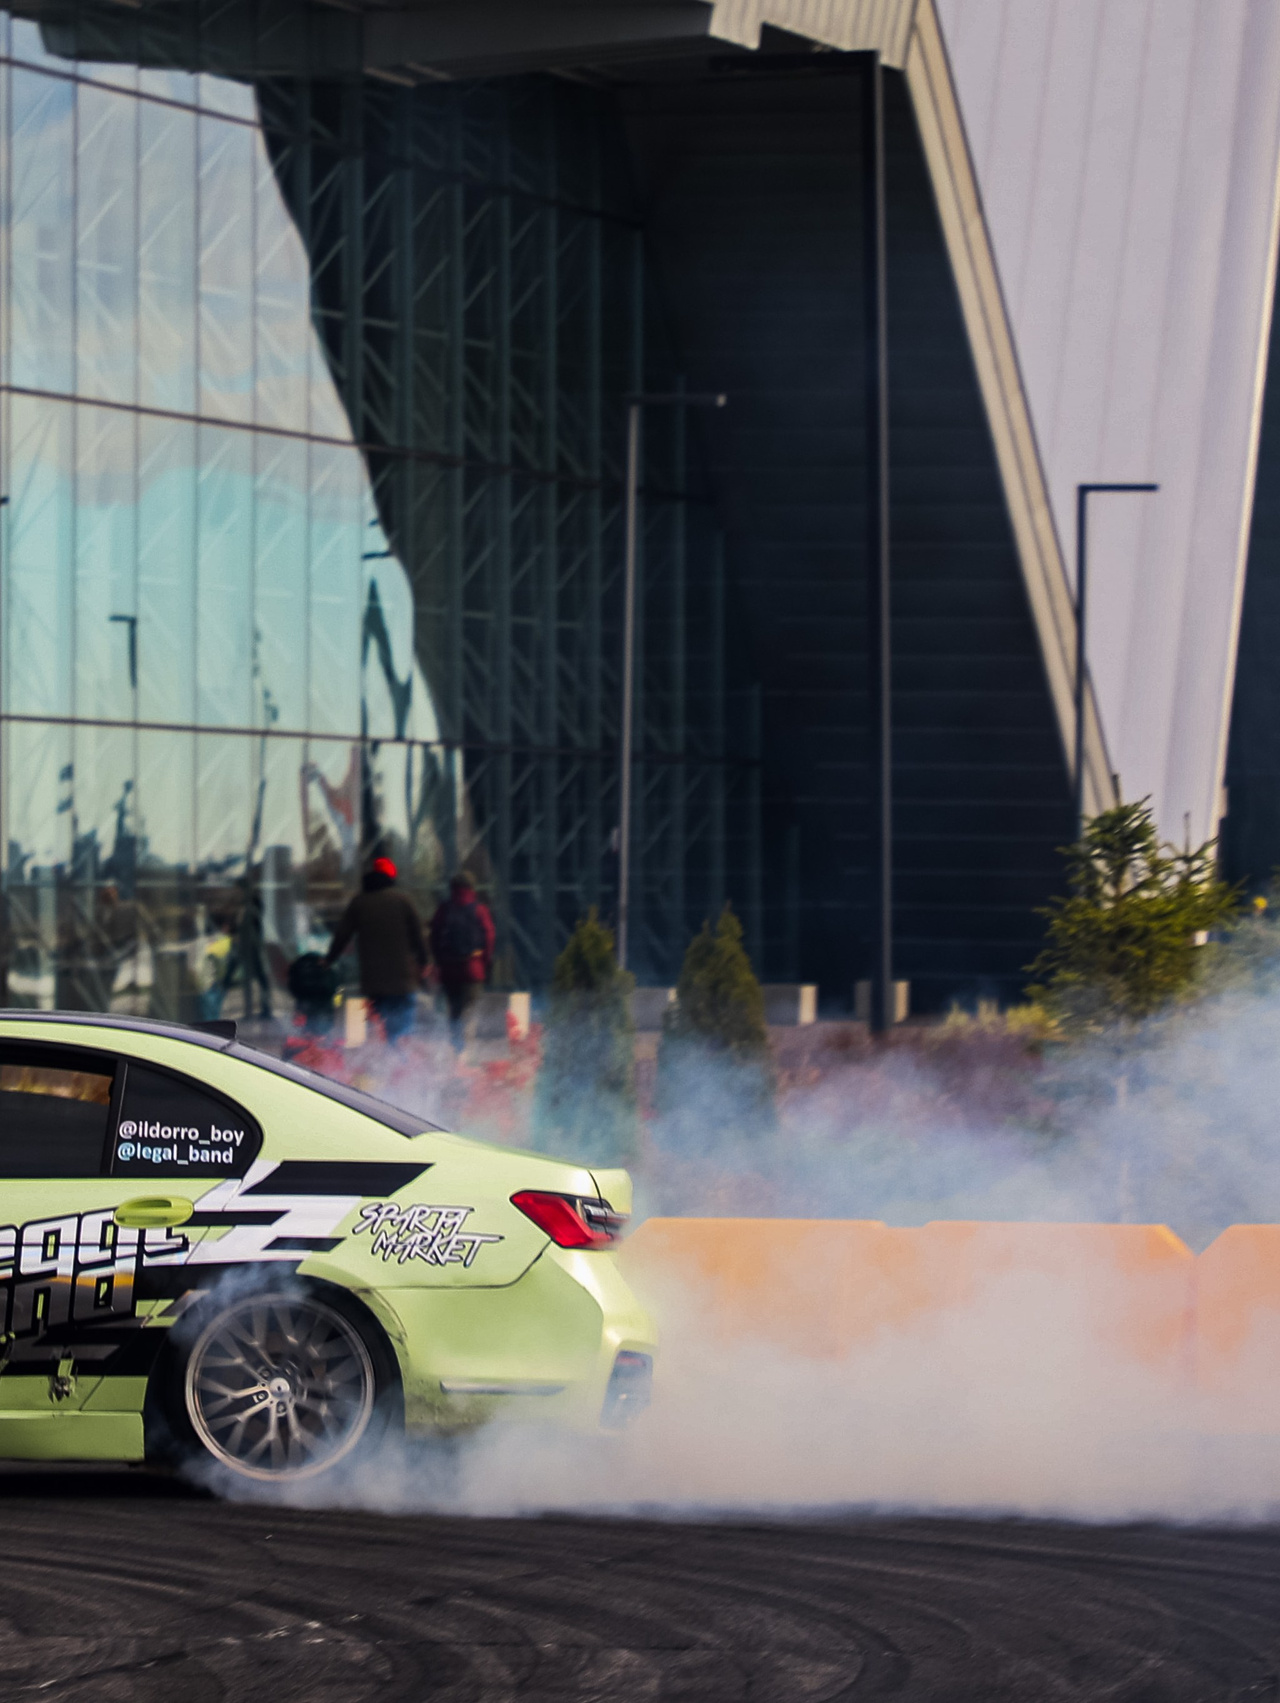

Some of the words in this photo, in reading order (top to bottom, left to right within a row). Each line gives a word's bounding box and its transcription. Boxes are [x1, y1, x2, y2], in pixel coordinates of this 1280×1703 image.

[119, 1120, 245, 1147] @ildorro_boy
[117, 1141, 234, 1166] @legal_band
[371, 1229, 505, 1268] MARKET
